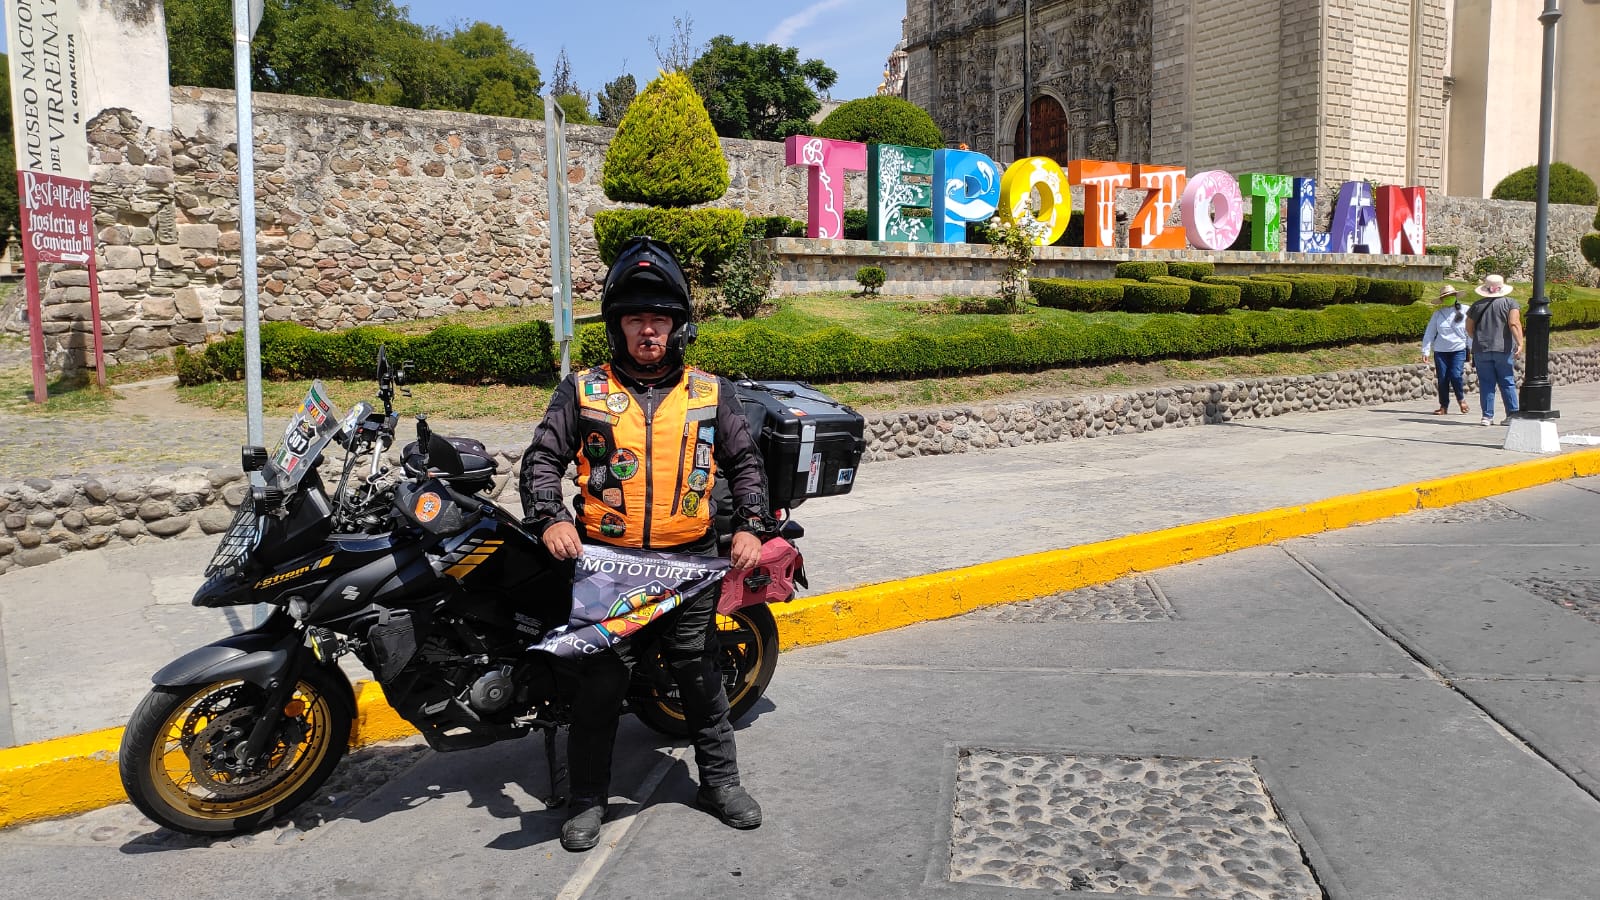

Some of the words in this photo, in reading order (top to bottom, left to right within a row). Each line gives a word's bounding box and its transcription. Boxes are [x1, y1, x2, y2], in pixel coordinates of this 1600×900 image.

[67, 34, 78, 106] CONACULTA
[24, 87, 42, 171] MUSEO
[50, 145, 62, 173] DEL
[23, 172, 91, 210] Restaurante
[785, 134, 1427, 255] TEPOTZOTLAN
[288, 430, 307, 451] 307
[650, 585, 661, 594] N
